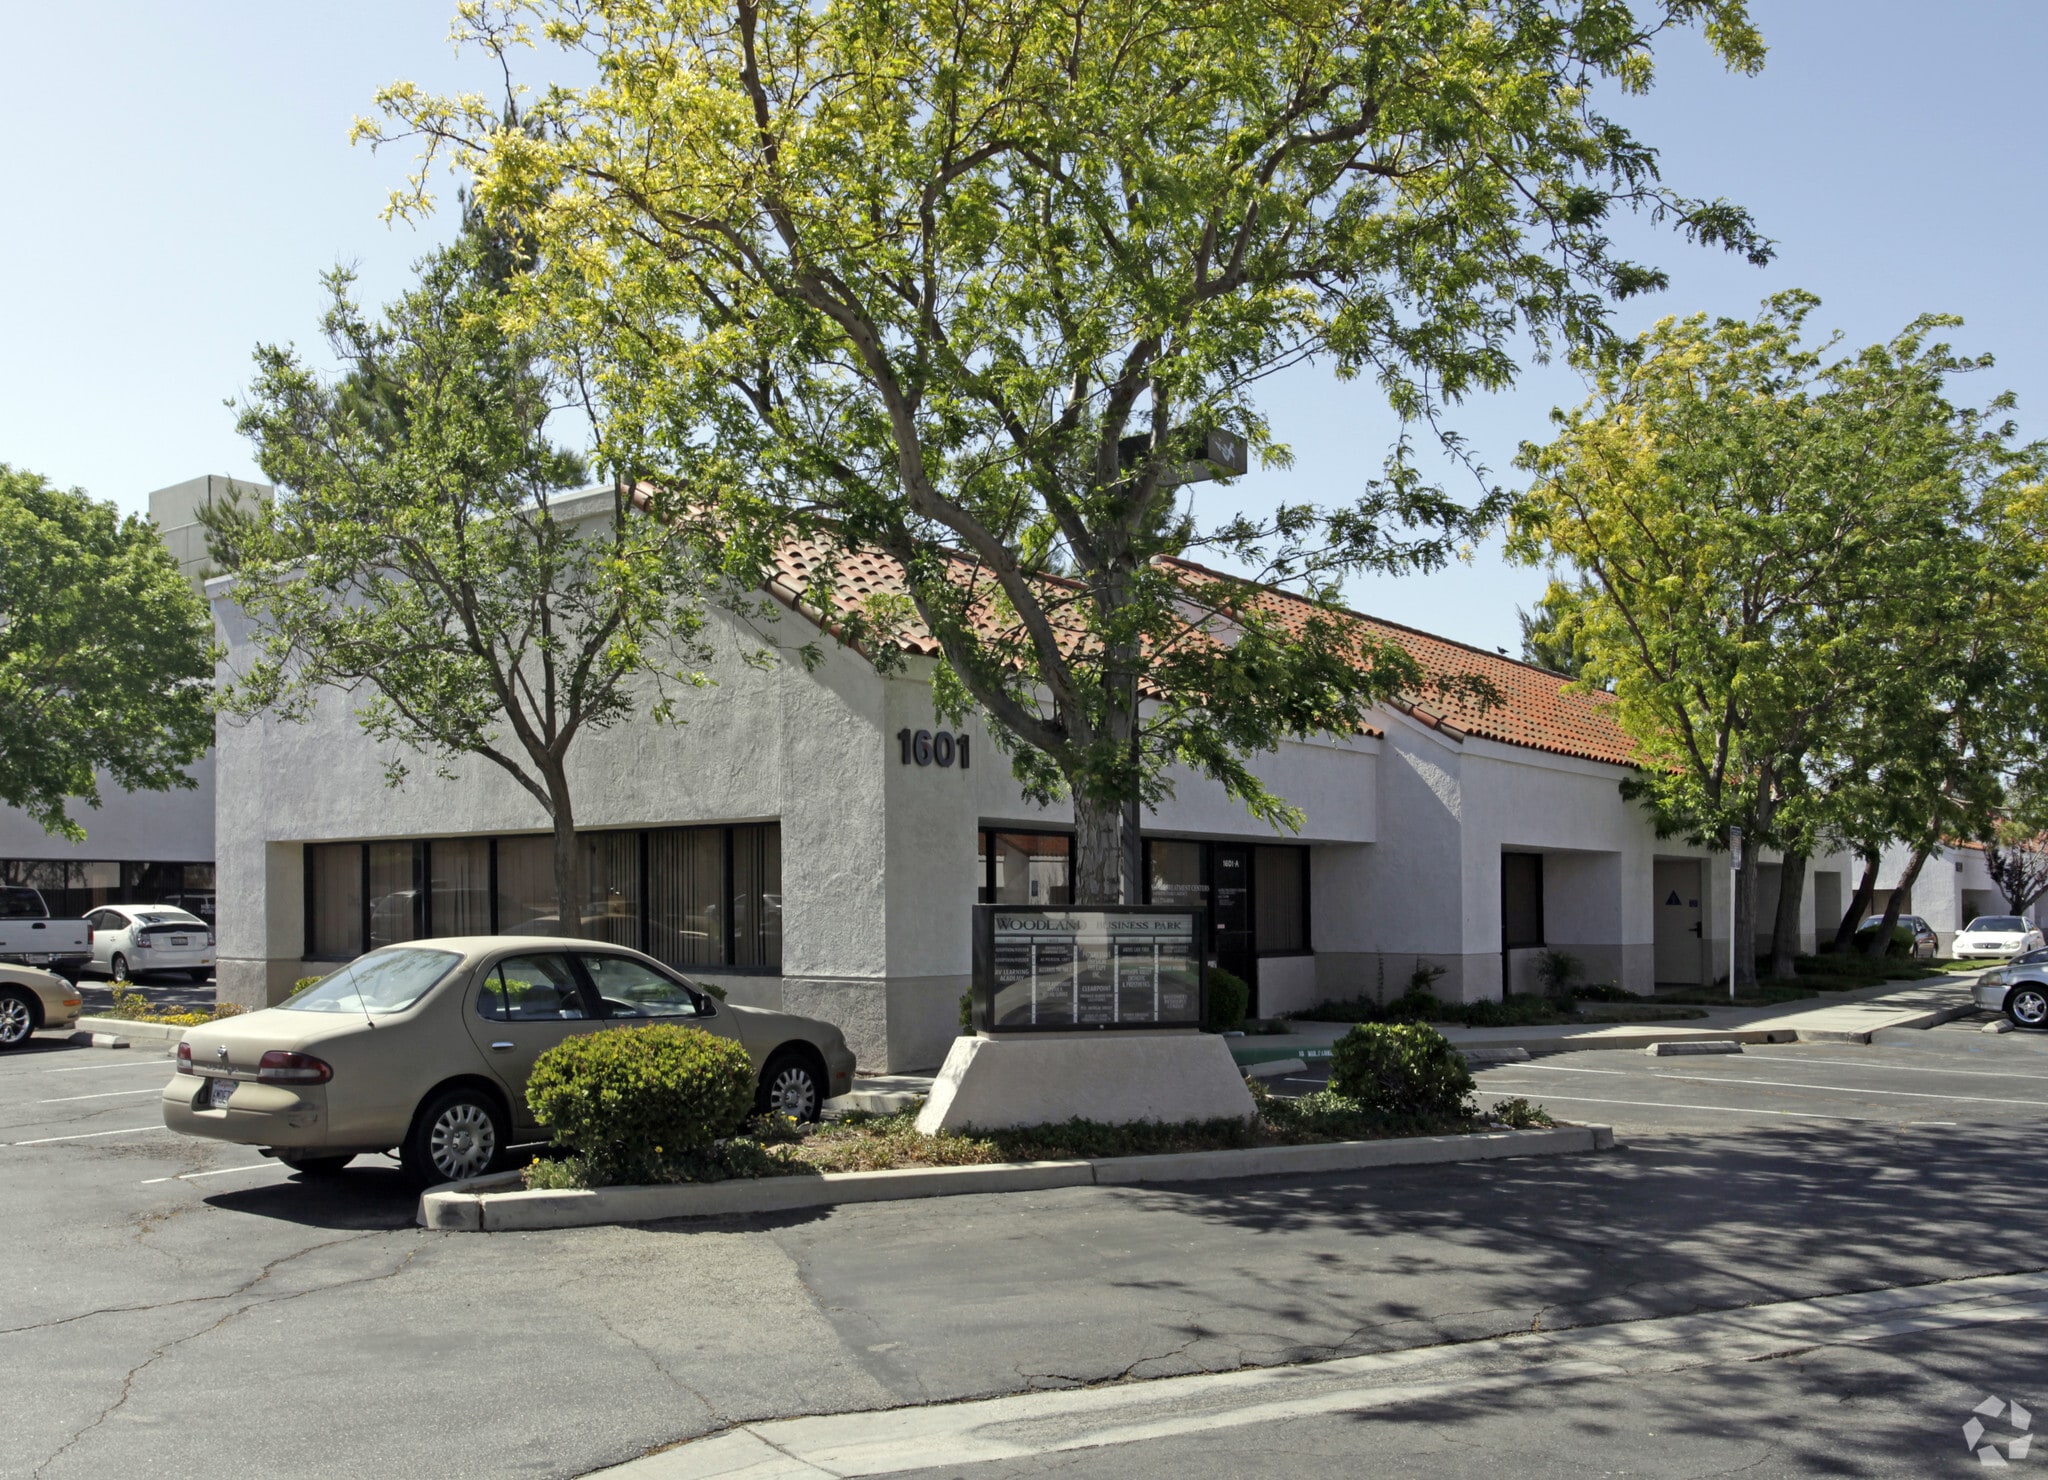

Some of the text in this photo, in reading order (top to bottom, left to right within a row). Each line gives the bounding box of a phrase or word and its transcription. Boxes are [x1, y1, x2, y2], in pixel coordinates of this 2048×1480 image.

[897, 728, 970, 769] 1601
[1222, 859, 1240, 868] 1601-A
[1154, 921, 1182, 930] PARK
